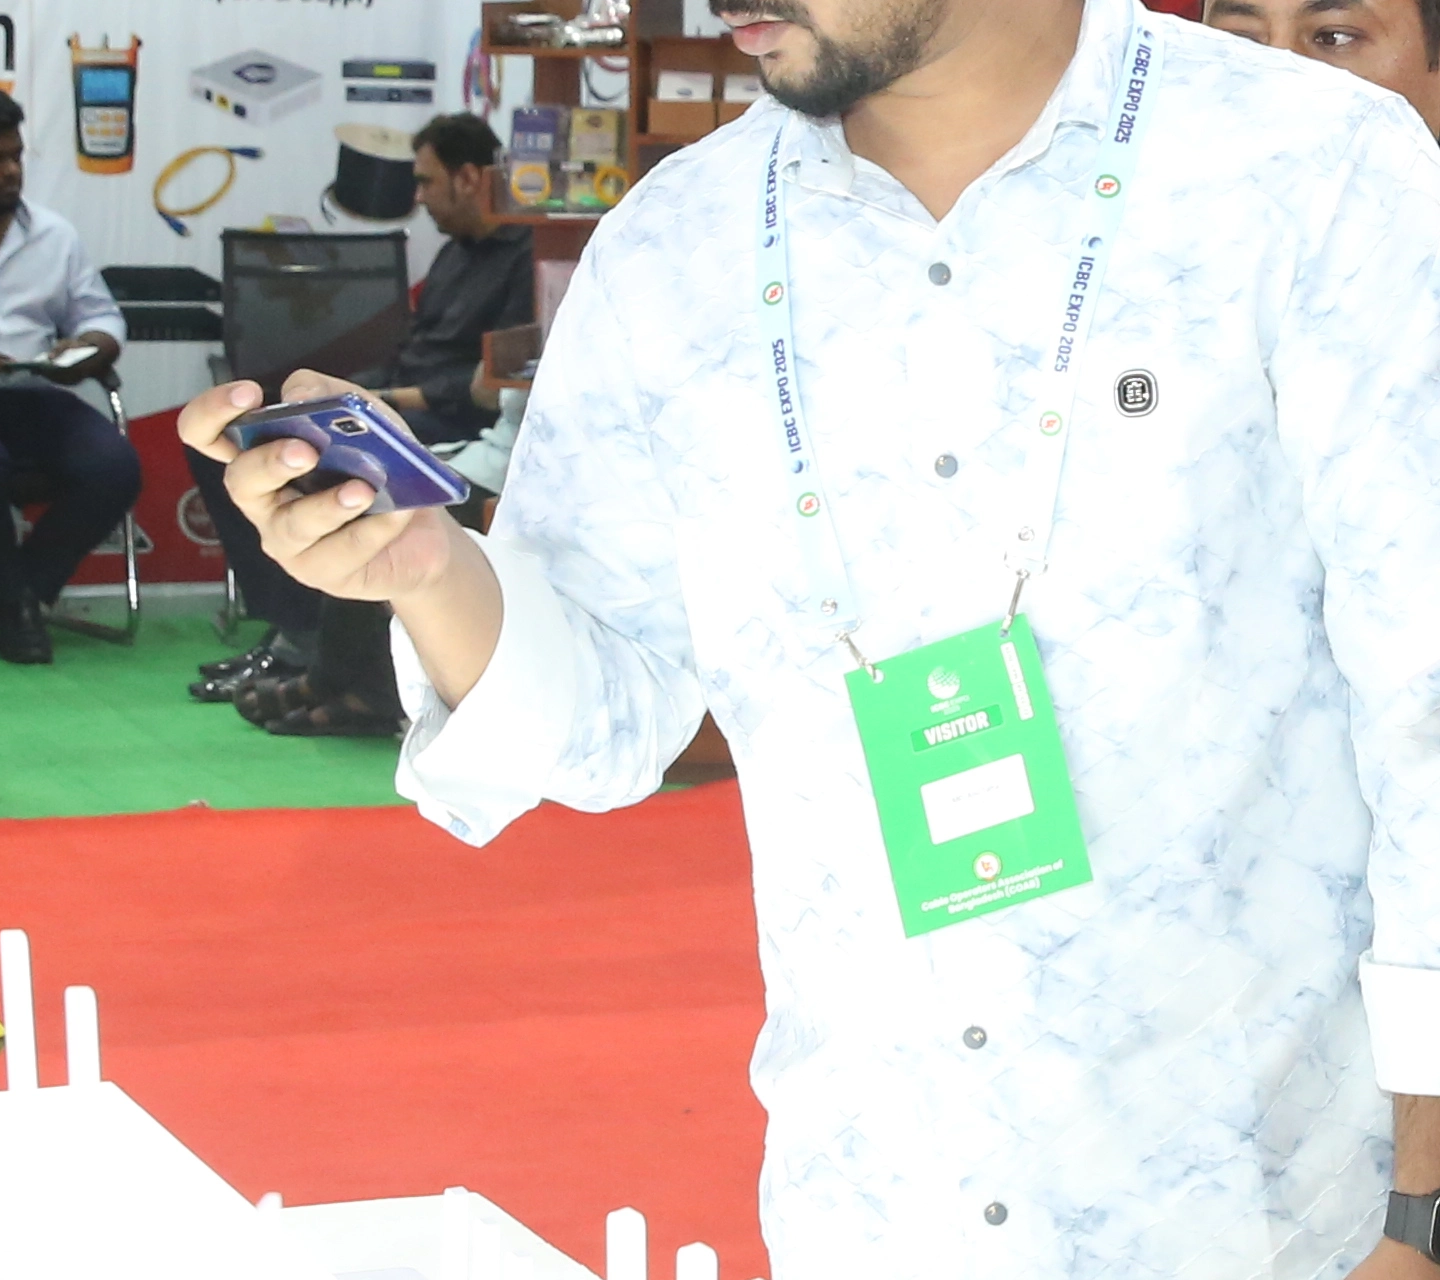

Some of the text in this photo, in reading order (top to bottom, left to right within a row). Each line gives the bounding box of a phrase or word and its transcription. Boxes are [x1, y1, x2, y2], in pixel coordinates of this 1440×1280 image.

[1114, 43, 1153, 145] ICBC EXPO 2025
[765, 193, 778, 230] ICBC
[1054, 256, 1096, 373] ICBC EXPO 2025
[772, 338, 803, 454] ICBC EXPO 2025
[923, 710, 990, 746] VISITOR
